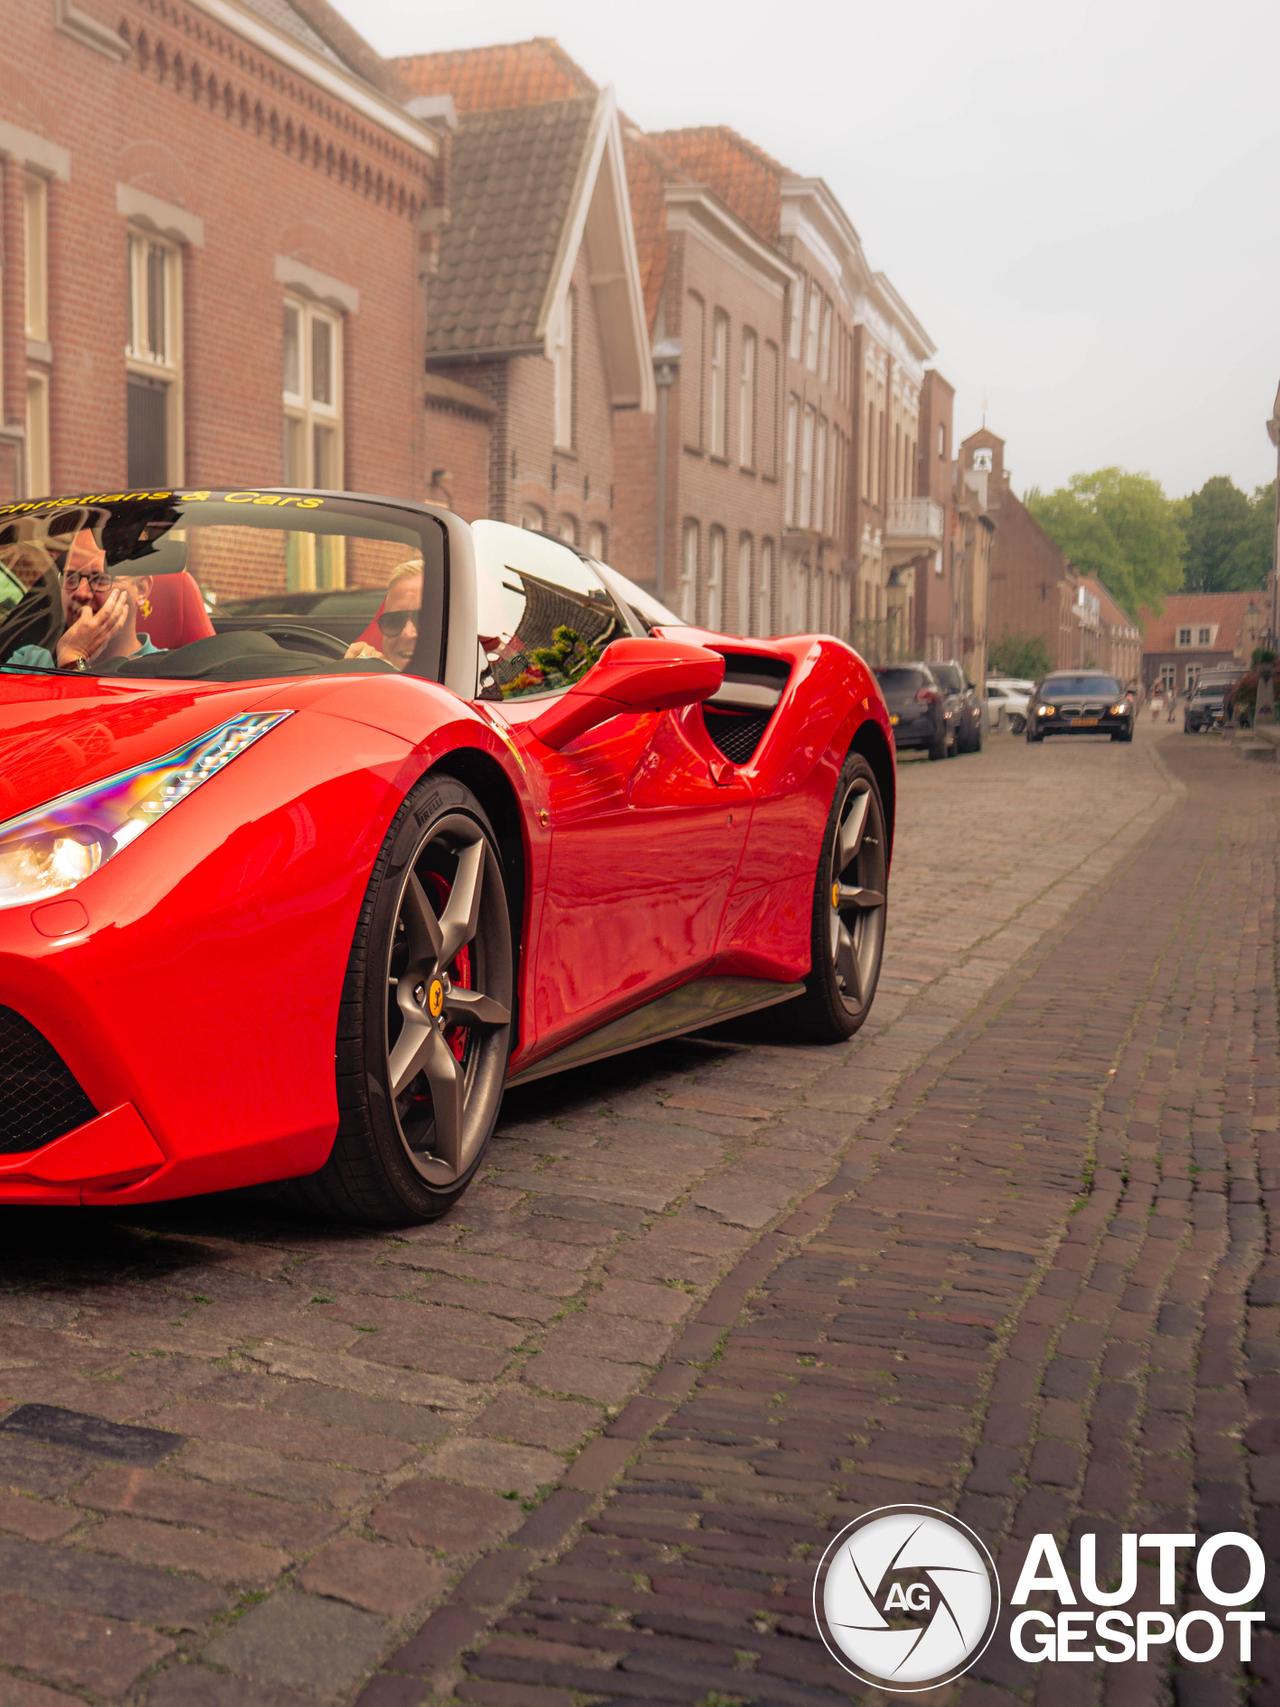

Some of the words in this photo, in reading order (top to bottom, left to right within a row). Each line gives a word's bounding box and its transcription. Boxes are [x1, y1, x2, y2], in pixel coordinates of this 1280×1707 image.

[181, 490, 212, 501] &
[224, 491, 325, 509] Cars
[413, 790, 443, 828] PIRELLI
